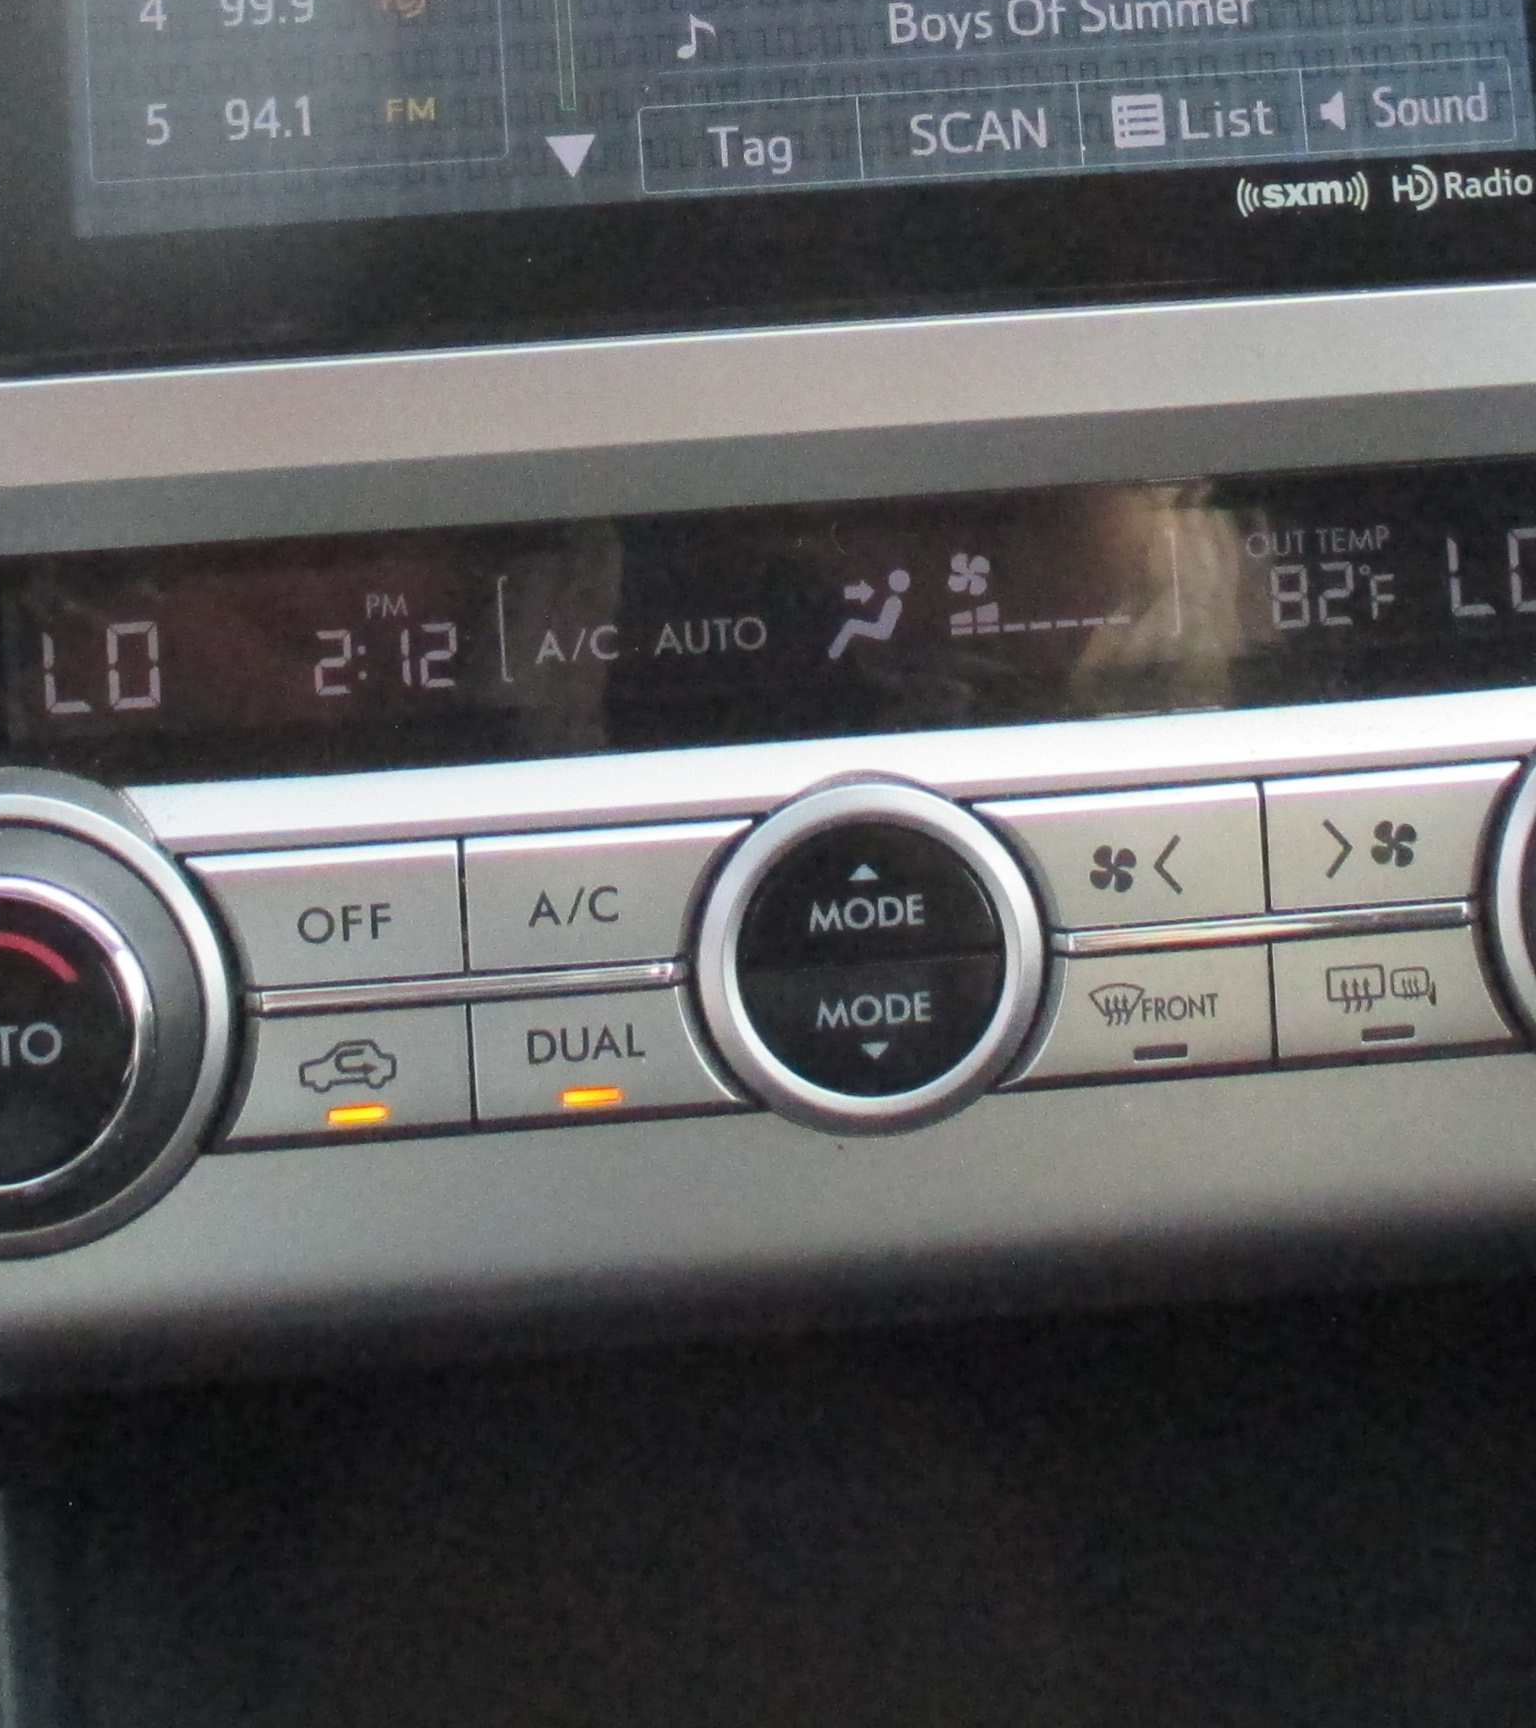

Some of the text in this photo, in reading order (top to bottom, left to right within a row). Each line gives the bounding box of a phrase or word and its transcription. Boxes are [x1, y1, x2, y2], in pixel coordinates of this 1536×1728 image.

[887, 0, 994, 50] Boys
[145, 95, 314, 146] 5 94.1
[386, 97, 436, 124] FM
[1178, 96, 1275, 141] List
[1372, 84, 1489, 129] Sound
[707, 123, 795, 175] Tag
[909, 107, 1049, 157] SCAN
[1444, 168, 1534, 199] Radio
[1246, 524, 1391, 560] OUT TEMP
[366, 593, 409, 619] PM
[314, 622, 458, 696] 2:12
[535, 617, 768, 665] A/C AUTO
[297, 903, 393, 944] OFF
[528, 885, 621, 928] A/C
[809, 892, 926, 933] MODE
[814, 986, 933, 1028] MODE
[1140, 988, 1219, 1024] FRONT
[525, 1022, 646, 1067] DUAL
